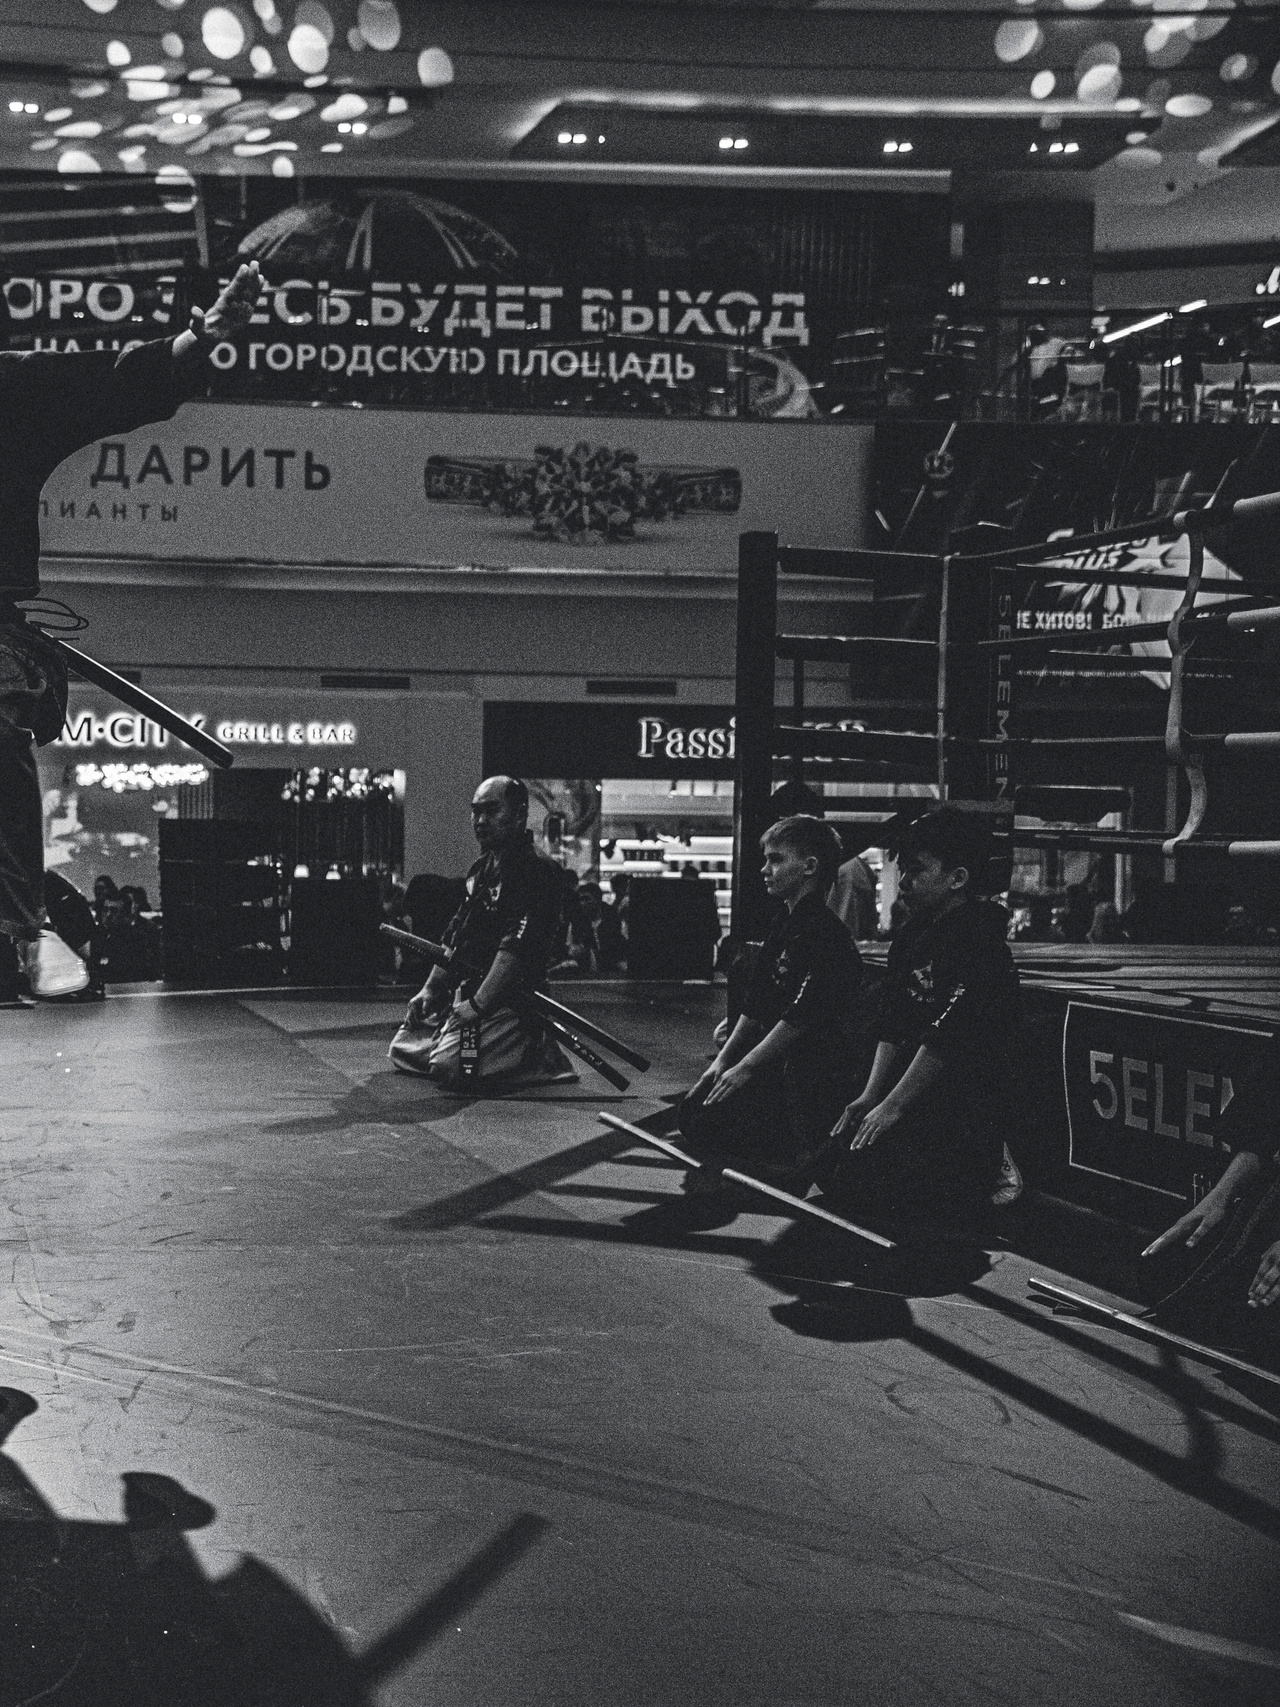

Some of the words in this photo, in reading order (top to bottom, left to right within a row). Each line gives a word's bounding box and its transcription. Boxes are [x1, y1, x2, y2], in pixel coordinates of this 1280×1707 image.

[371, 281, 564, 338] БУДЕТ
[581, 287, 810, 346] ВЫХОД
[248, 342, 487, 377] ГОРОДСКУЮ
[497, 347, 696, 387] ПЛОЩАДЬ
[89, 442, 332, 491] ДАРИТЬ
[220, 725, 283, 743] GRILL
[291, 726, 306, 743] &
[309, 725, 353, 744] BAR
[637, 716, 736, 759] Passi
